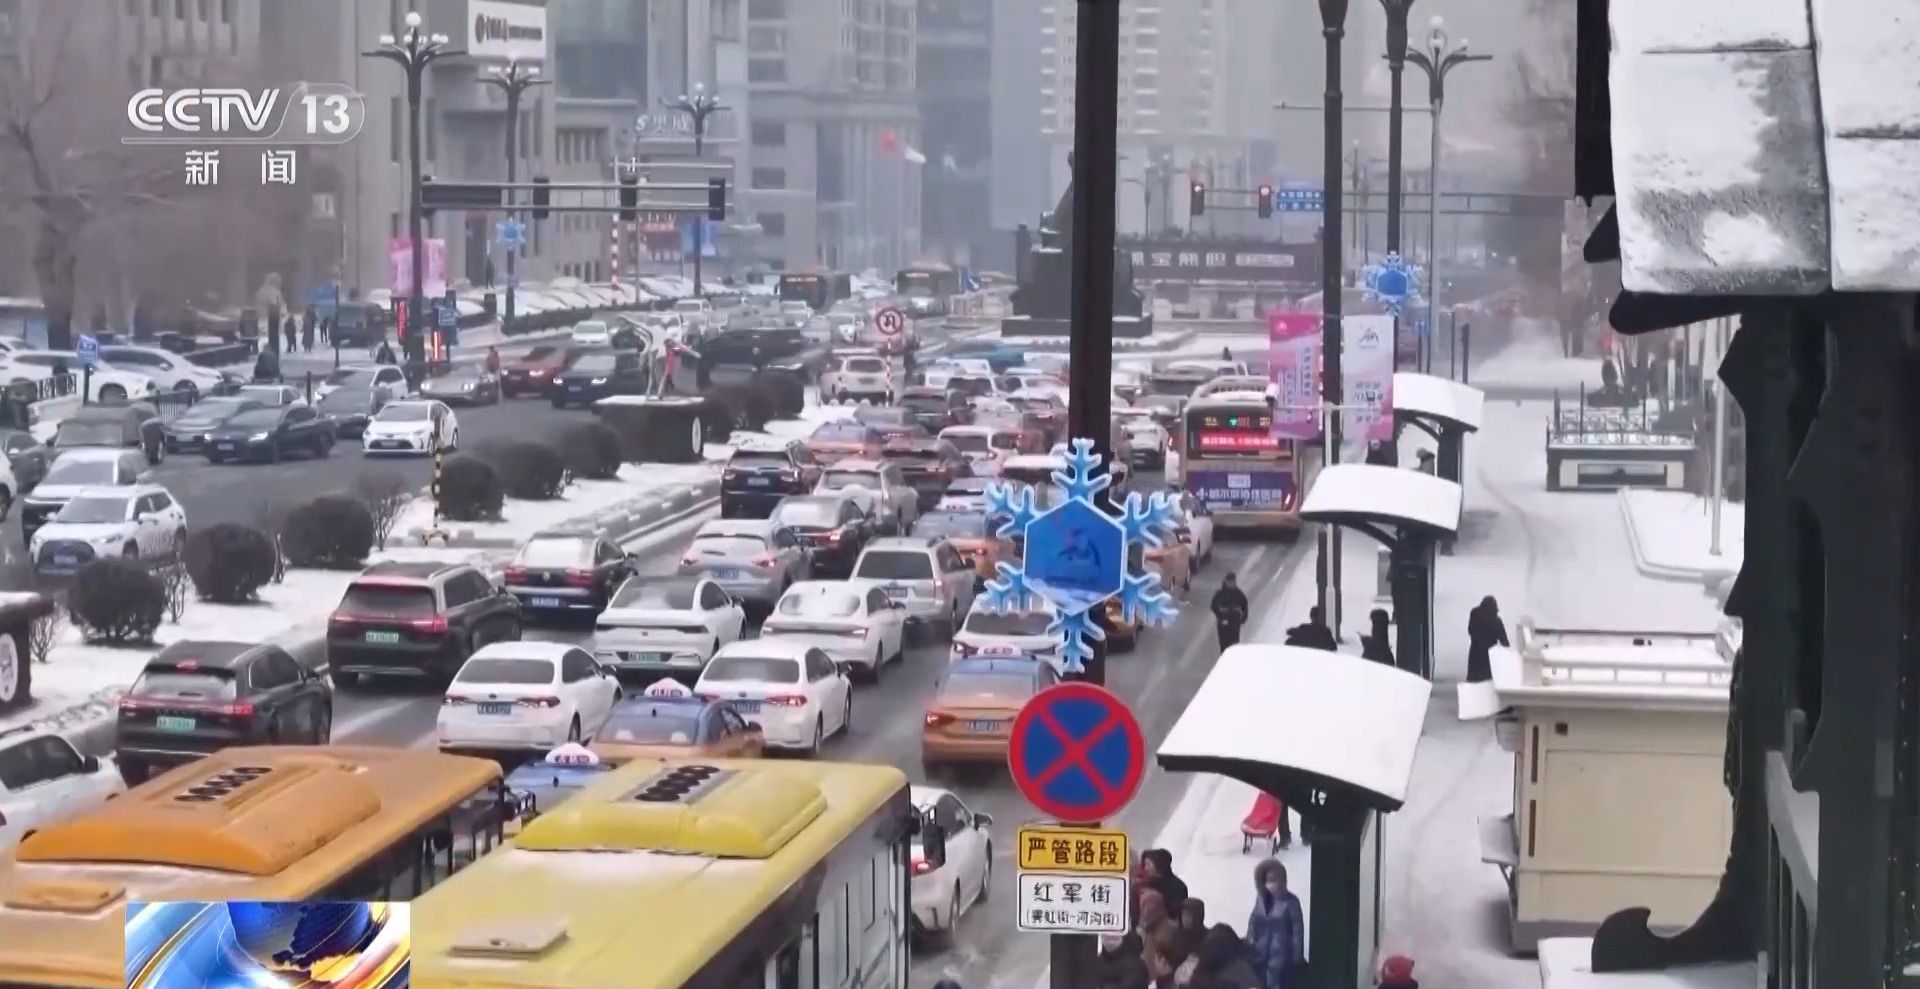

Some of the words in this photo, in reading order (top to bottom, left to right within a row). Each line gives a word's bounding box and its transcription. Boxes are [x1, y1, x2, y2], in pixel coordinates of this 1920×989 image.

[1027, 837, 1119, 867] 严管路段
[1033, 881, 1111, 904] 红军街
